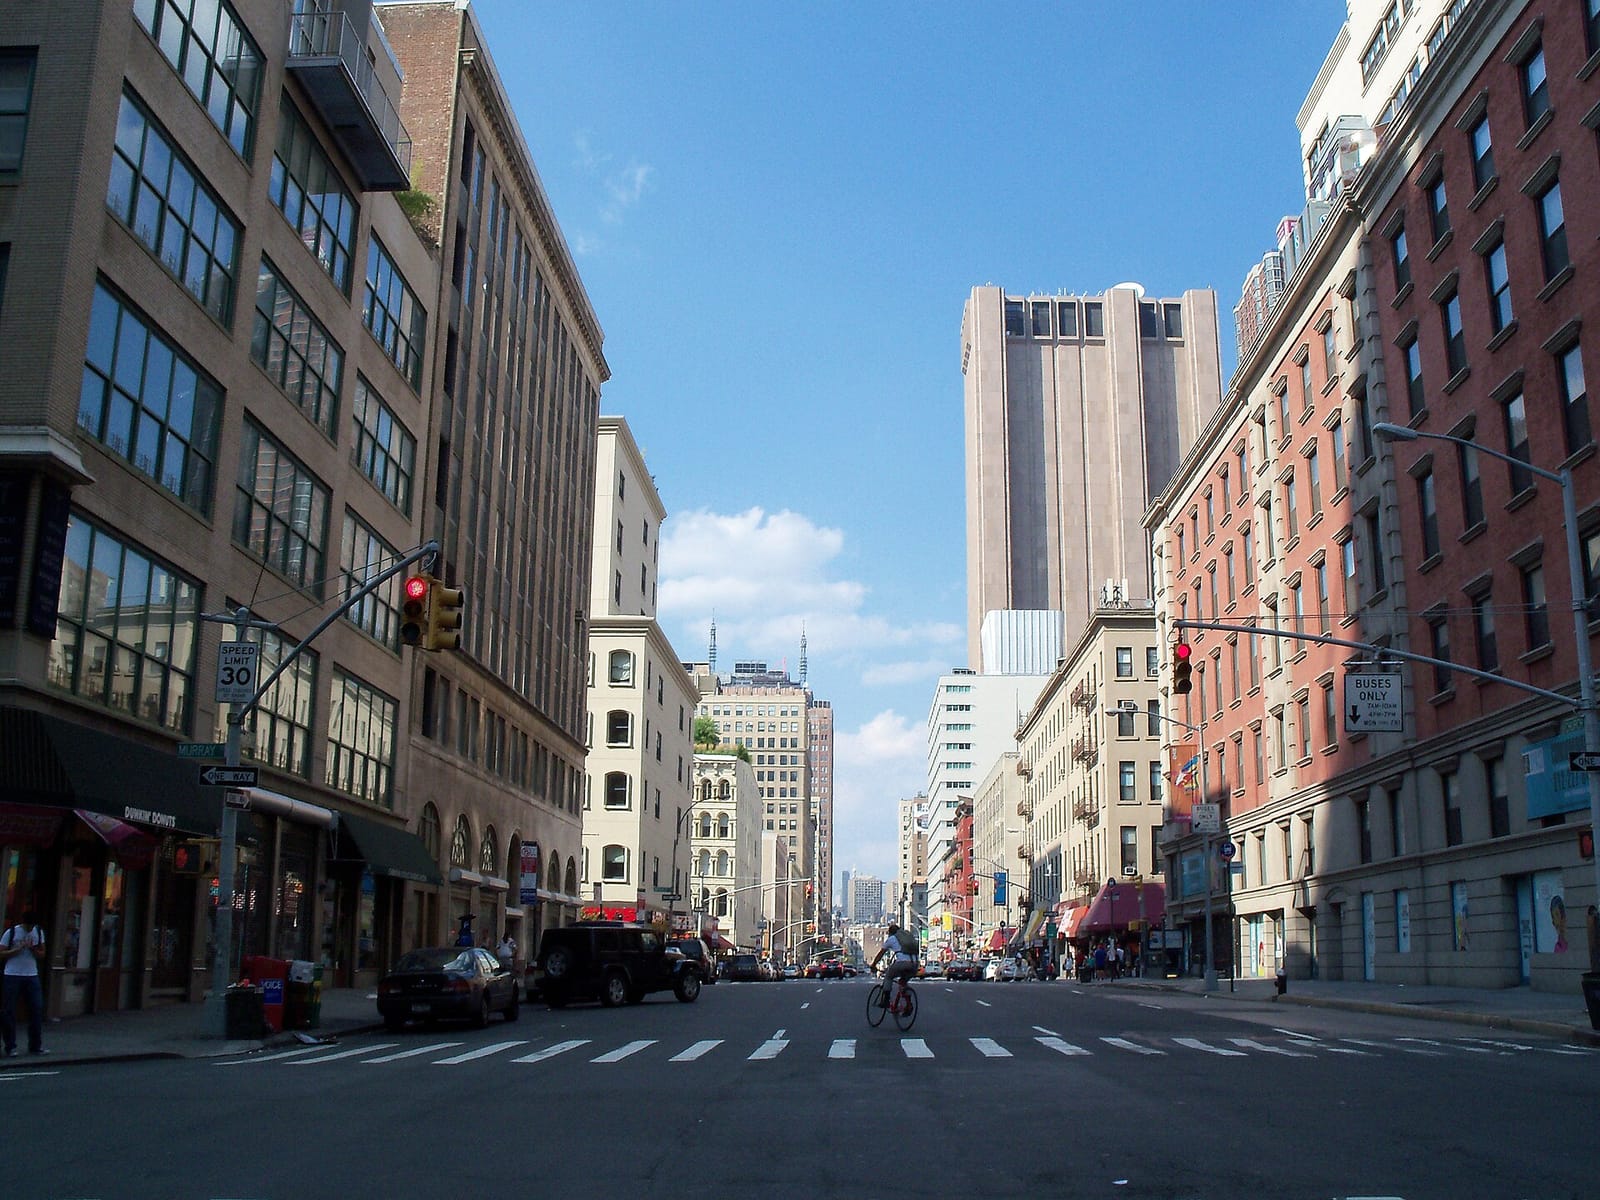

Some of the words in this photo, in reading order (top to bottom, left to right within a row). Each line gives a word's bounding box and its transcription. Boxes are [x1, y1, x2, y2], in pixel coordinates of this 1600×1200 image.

[222, 646, 255, 655] SPEED
[224, 657, 250, 665] LIMIT
[221, 667, 251, 685] 30
[1356, 679, 1391, 688] BUSES
[1359, 691, 1387, 701] ONLY
[178, 744, 216, 756] MURRAY
[1578, 757, 1596, 766] ONE
[208, 771, 225, 780] ONE
[232, 771, 251, 780] WAY
[151, 811, 177, 828] DONUTS
